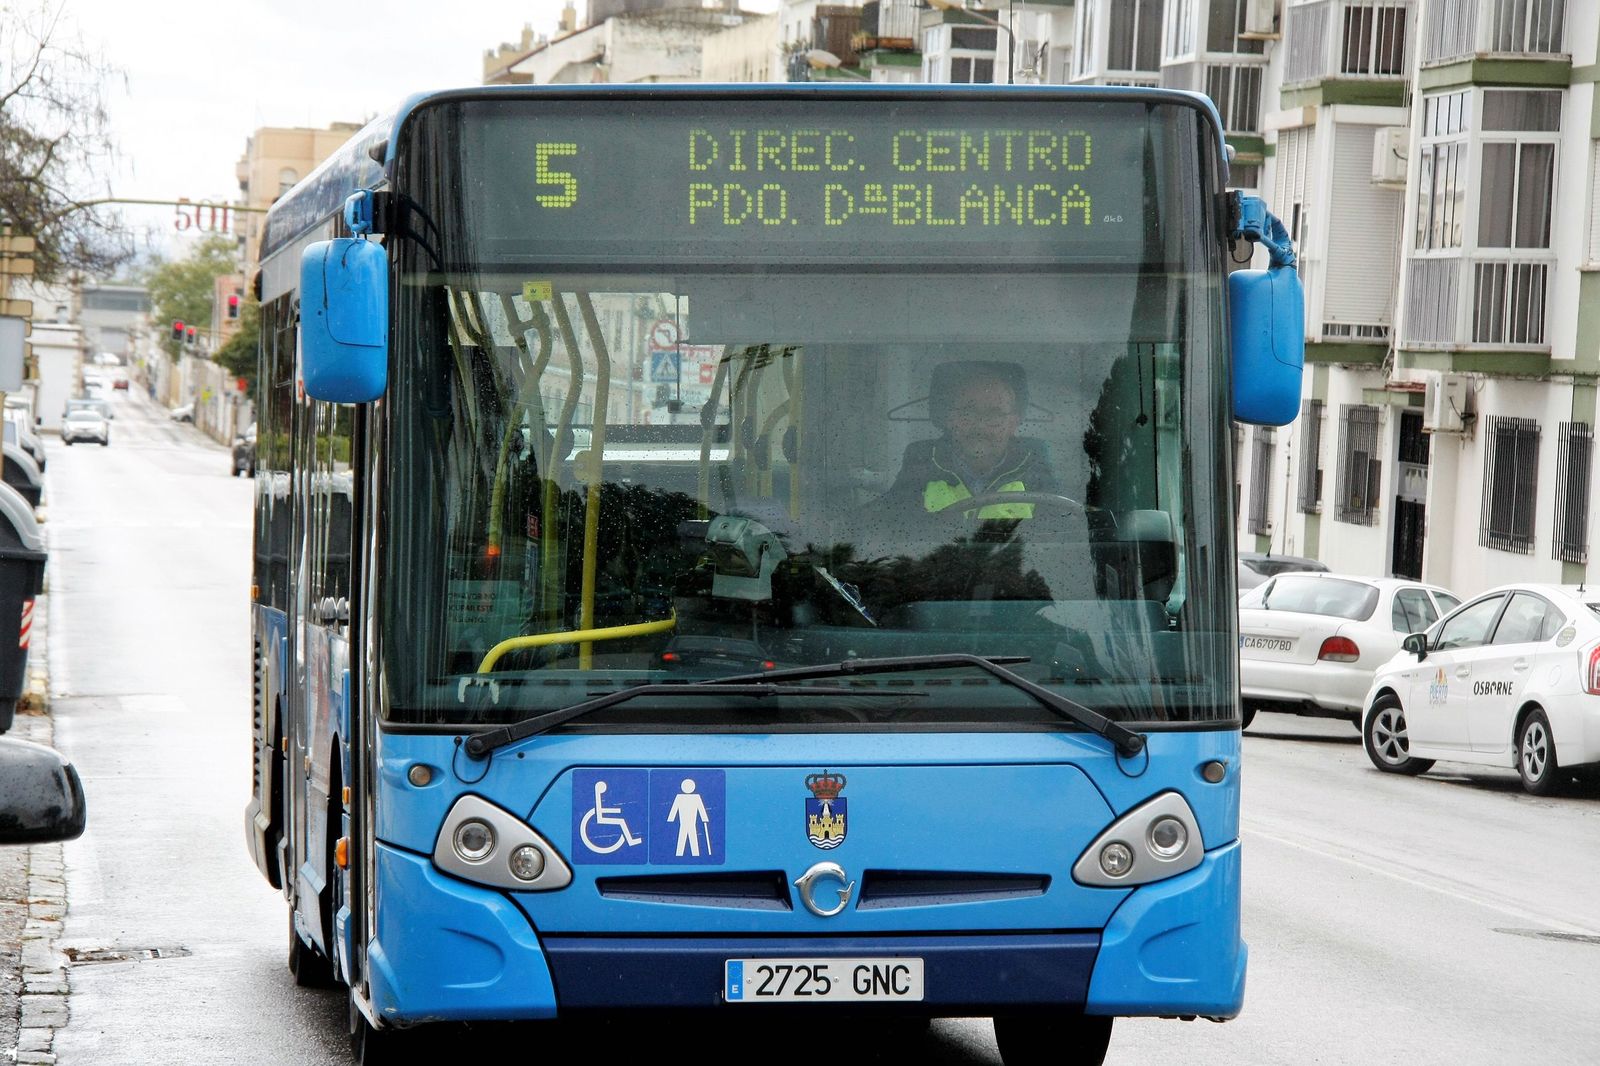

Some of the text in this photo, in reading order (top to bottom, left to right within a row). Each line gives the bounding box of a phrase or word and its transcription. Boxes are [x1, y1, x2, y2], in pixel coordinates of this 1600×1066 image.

[689, 130, 1092, 172] DIREC. CENTRO
[536, 143, 577, 208] 5
[689, 183, 797, 225] PDO.
[732, 985, 738, 993] E
[755, 964, 910, 996] 2725 GNC
